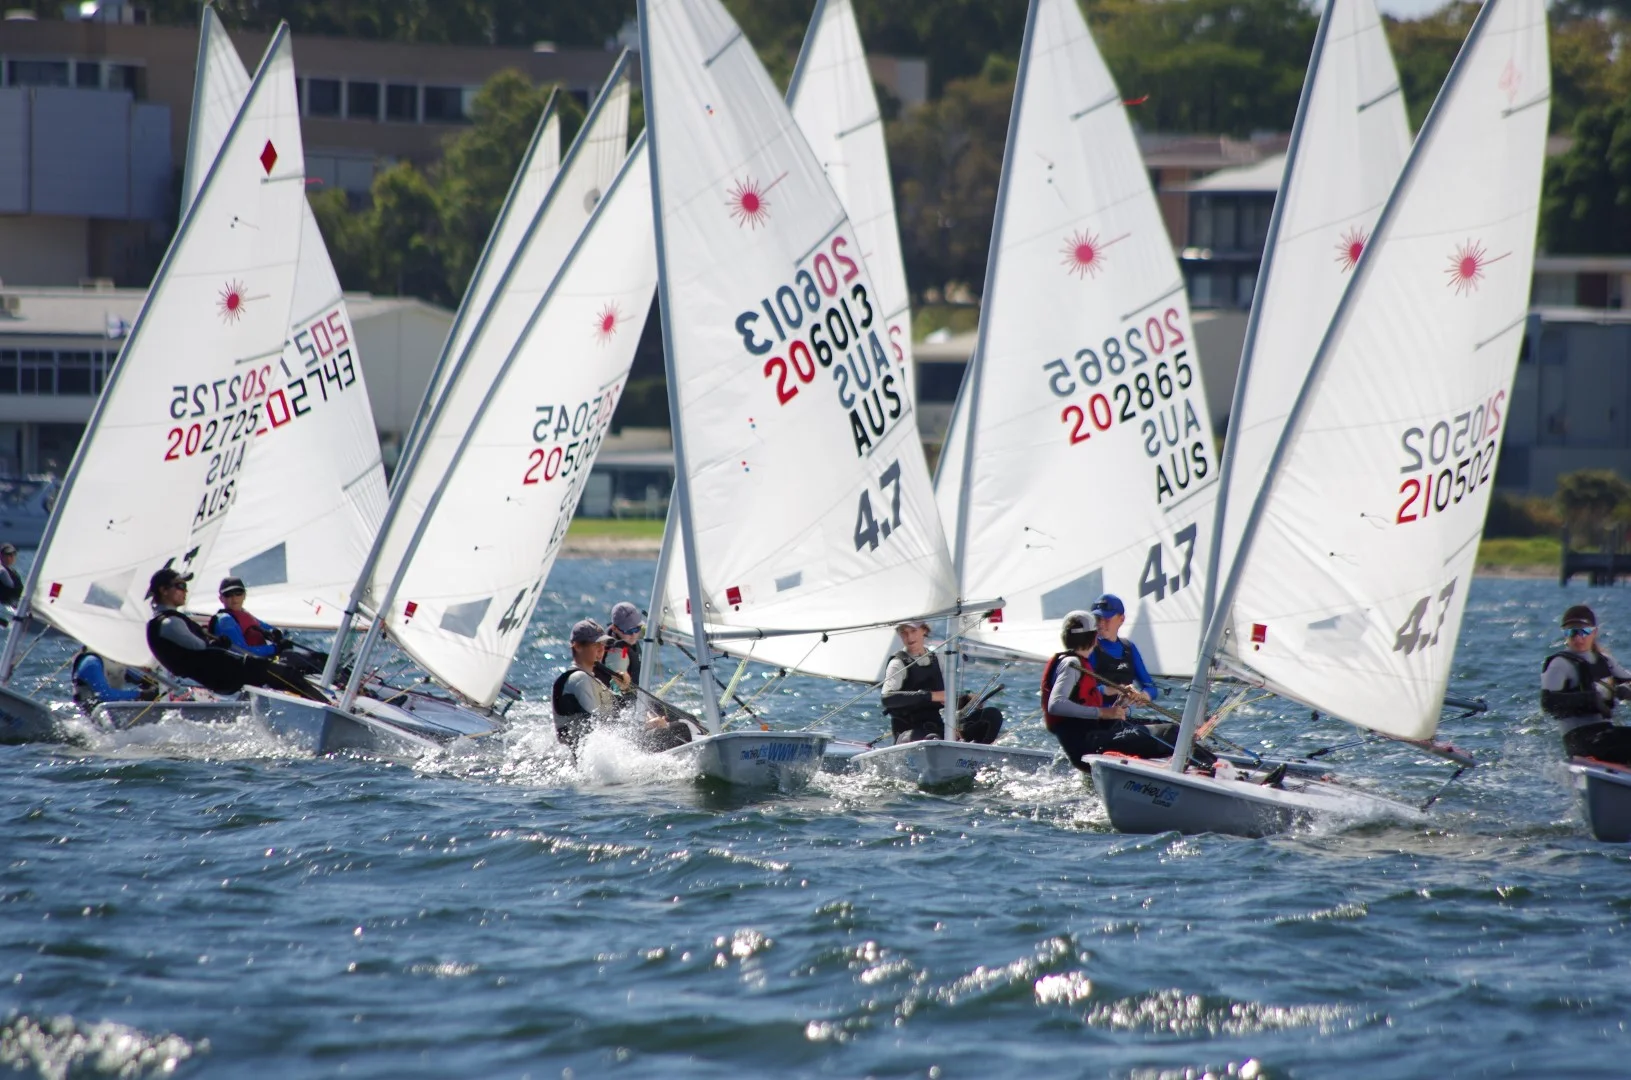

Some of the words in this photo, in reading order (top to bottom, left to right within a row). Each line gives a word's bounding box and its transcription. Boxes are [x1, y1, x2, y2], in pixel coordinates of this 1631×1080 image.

[763, 283, 874, 407] 206013
[163, 401, 264, 463] 202725
[256, 348, 357, 437] 02743
[849, 374, 902, 458] AUS
[1060, 349, 1193, 447] 202865
[191, 479, 236, 528] AUS
[853, 458, 902, 553] 4.7
[1155, 440, 1209, 505] AUS
[1395, 439, 1496, 526] 210502
[1137, 521, 1198, 605] 4.7
[1392, 575, 1459, 656] 4.7
